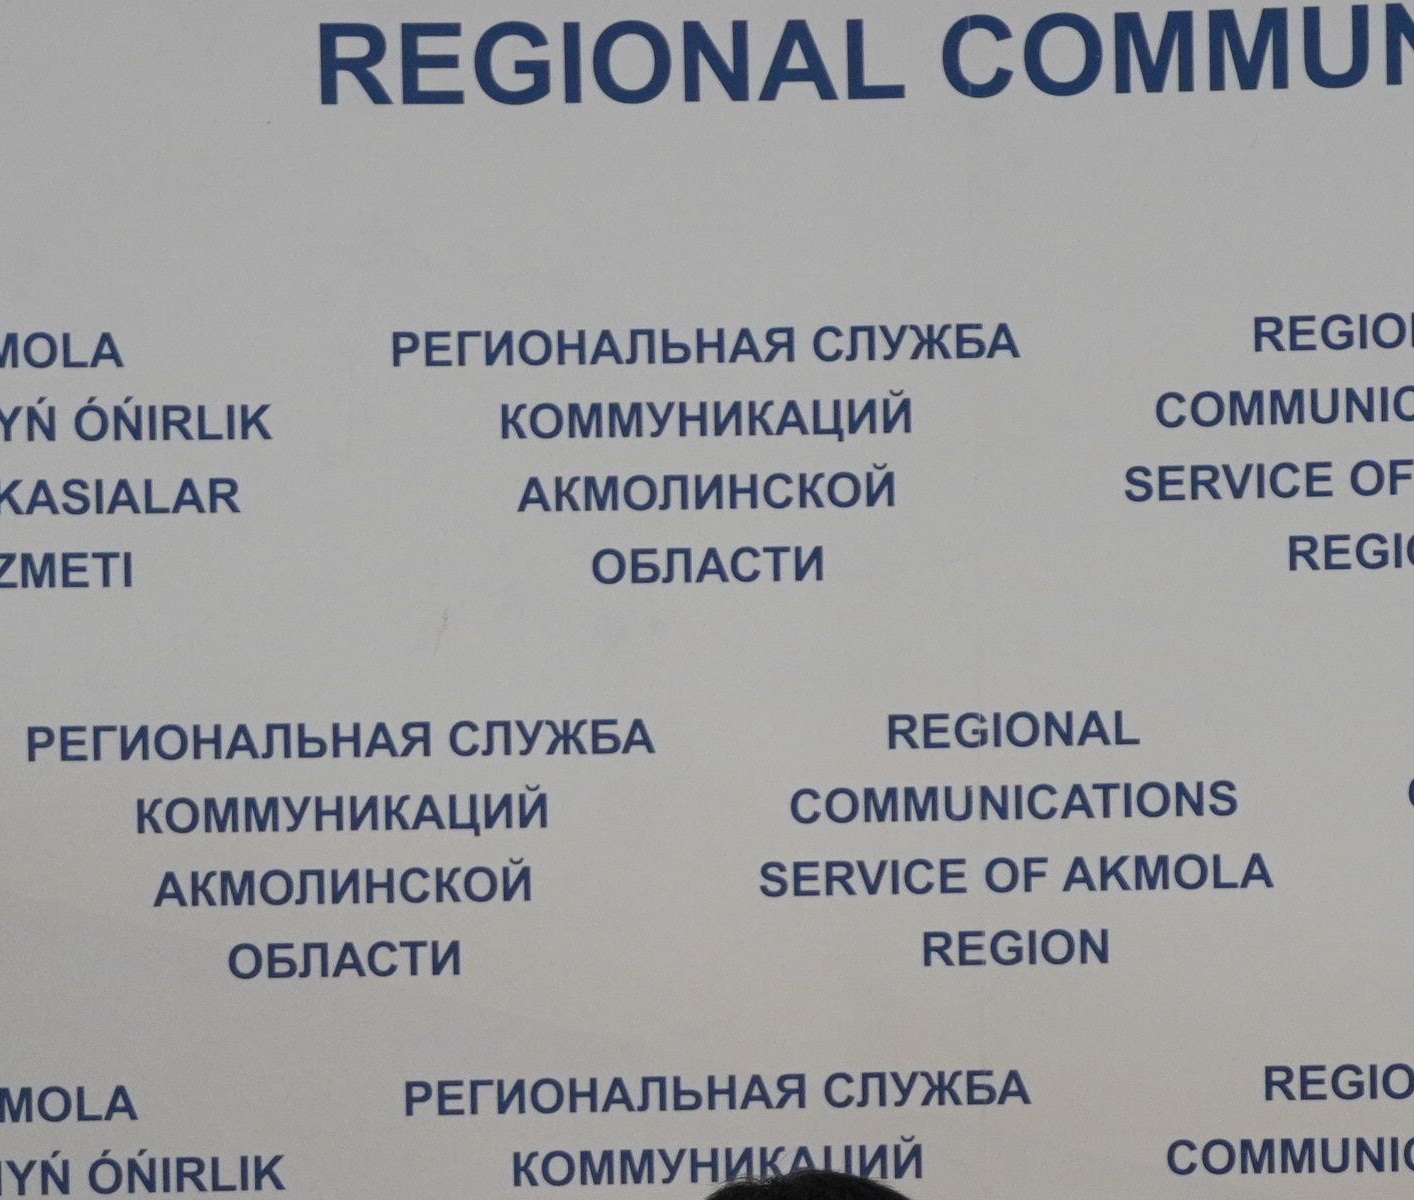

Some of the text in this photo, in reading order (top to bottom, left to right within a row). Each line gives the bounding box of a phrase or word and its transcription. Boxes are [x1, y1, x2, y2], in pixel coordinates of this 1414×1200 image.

[318, 14, 907, 106] REGIONAL
[391, 321, 1021, 368] РЕГИОНАЛЬНАЯ СЛУЖБА
[73, 392, 273, 442] ÓŃIRLIK
[500, 387, 913, 442] КОММУНИКАЦИЙ
[516, 460, 896, 513] АКМОЛИНСКОЙ
[1124, 460, 1334, 503] SERVICE
[591, 544, 824, 585] ОБЛАСТИ
[26, 717, 657, 762] РЕГИОНАЛЬНАЯ СЛУЖБА
[887, 709, 1141, 750] REGIONAL
[135, 781, 549, 836] КОММУНИКАЦИЙ
[789, 778, 1239, 825] COMMUNICATIONS
[153, 862, 532, 906] АКМОЛИНСКОЙ
[759, 851, 1275, 898] SERVICE OF AKMOLA
[227, 939, 462, 980] ОБЛАСТИ
[922, 927, 1110, 967] REGION
[403, 1068, 1031, 1117] РЕГИОНАЛЬНАЯ СЛУЖБА
[86, 1144, 286, 1196] ÓŃIRLIK
